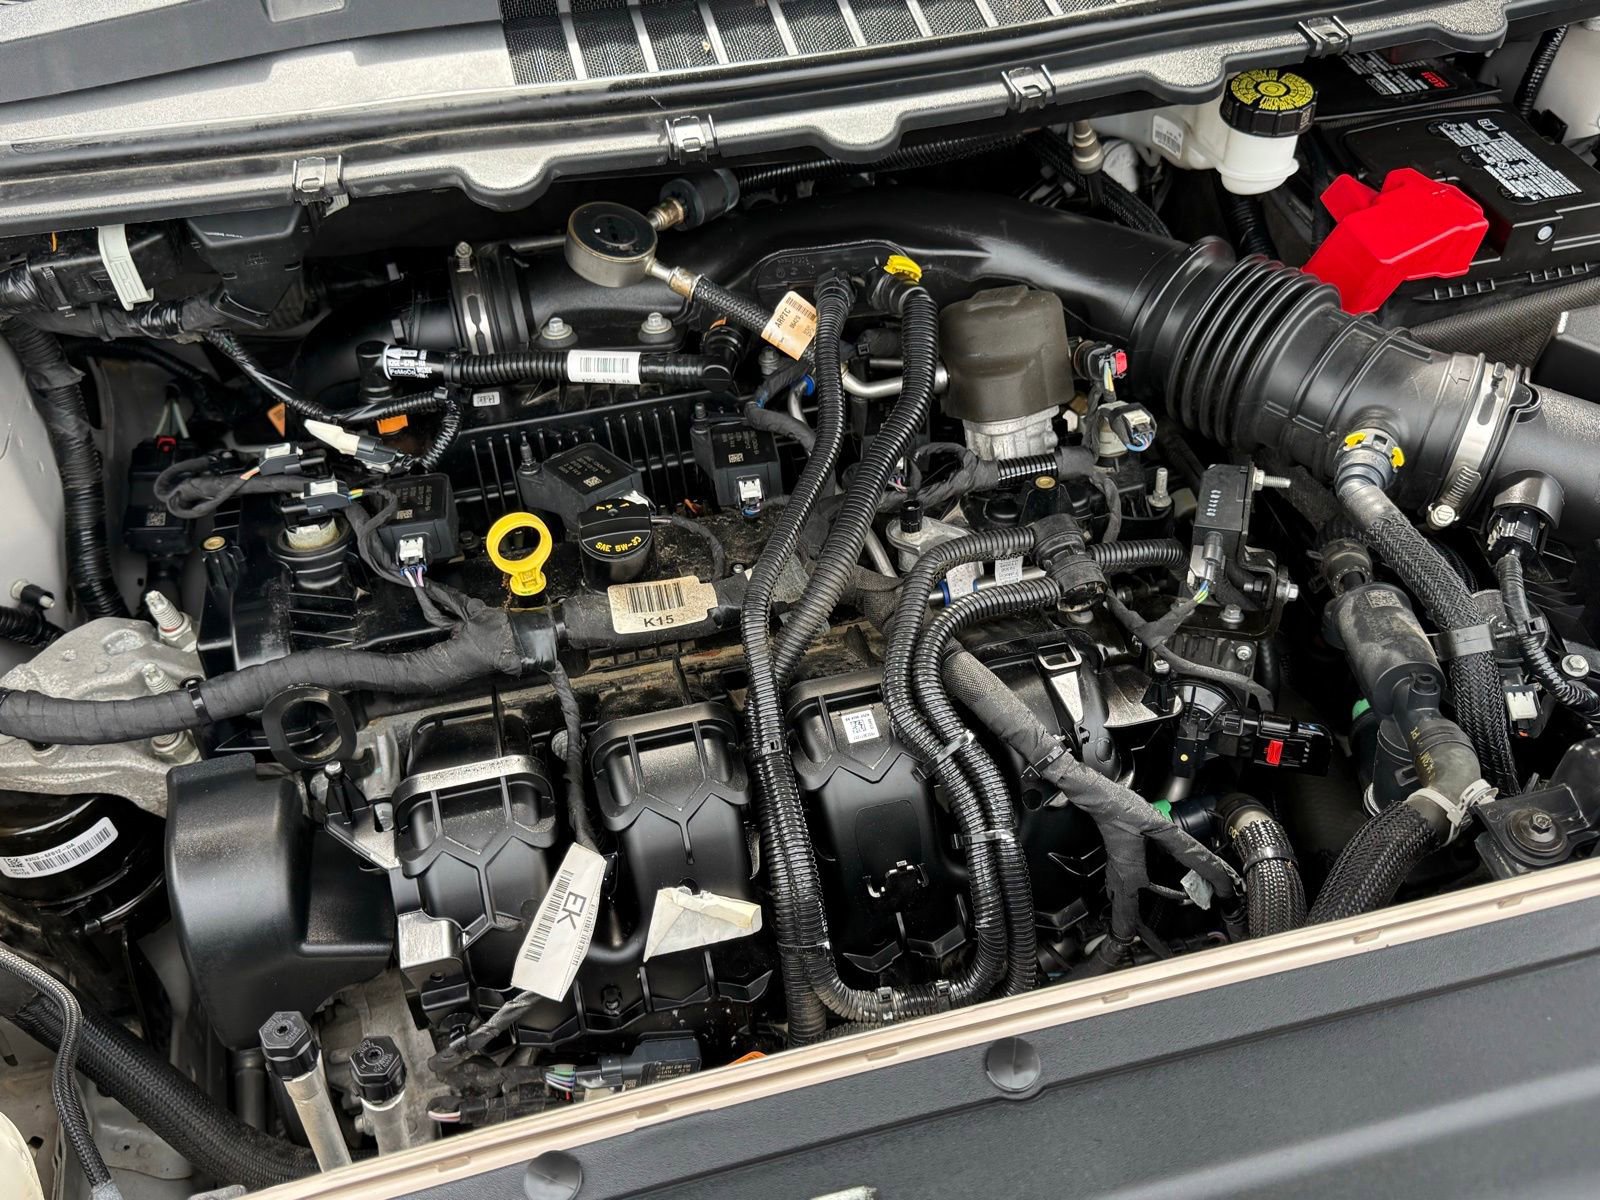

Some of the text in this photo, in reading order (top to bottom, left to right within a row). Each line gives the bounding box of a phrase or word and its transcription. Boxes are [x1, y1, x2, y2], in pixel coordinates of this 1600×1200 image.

[774, 307, 791, 329] ARPTC
[595, 541, 612, 553] SAE
[643, 614, 675, 628] K15
[556, 890, 587, 930] EK
